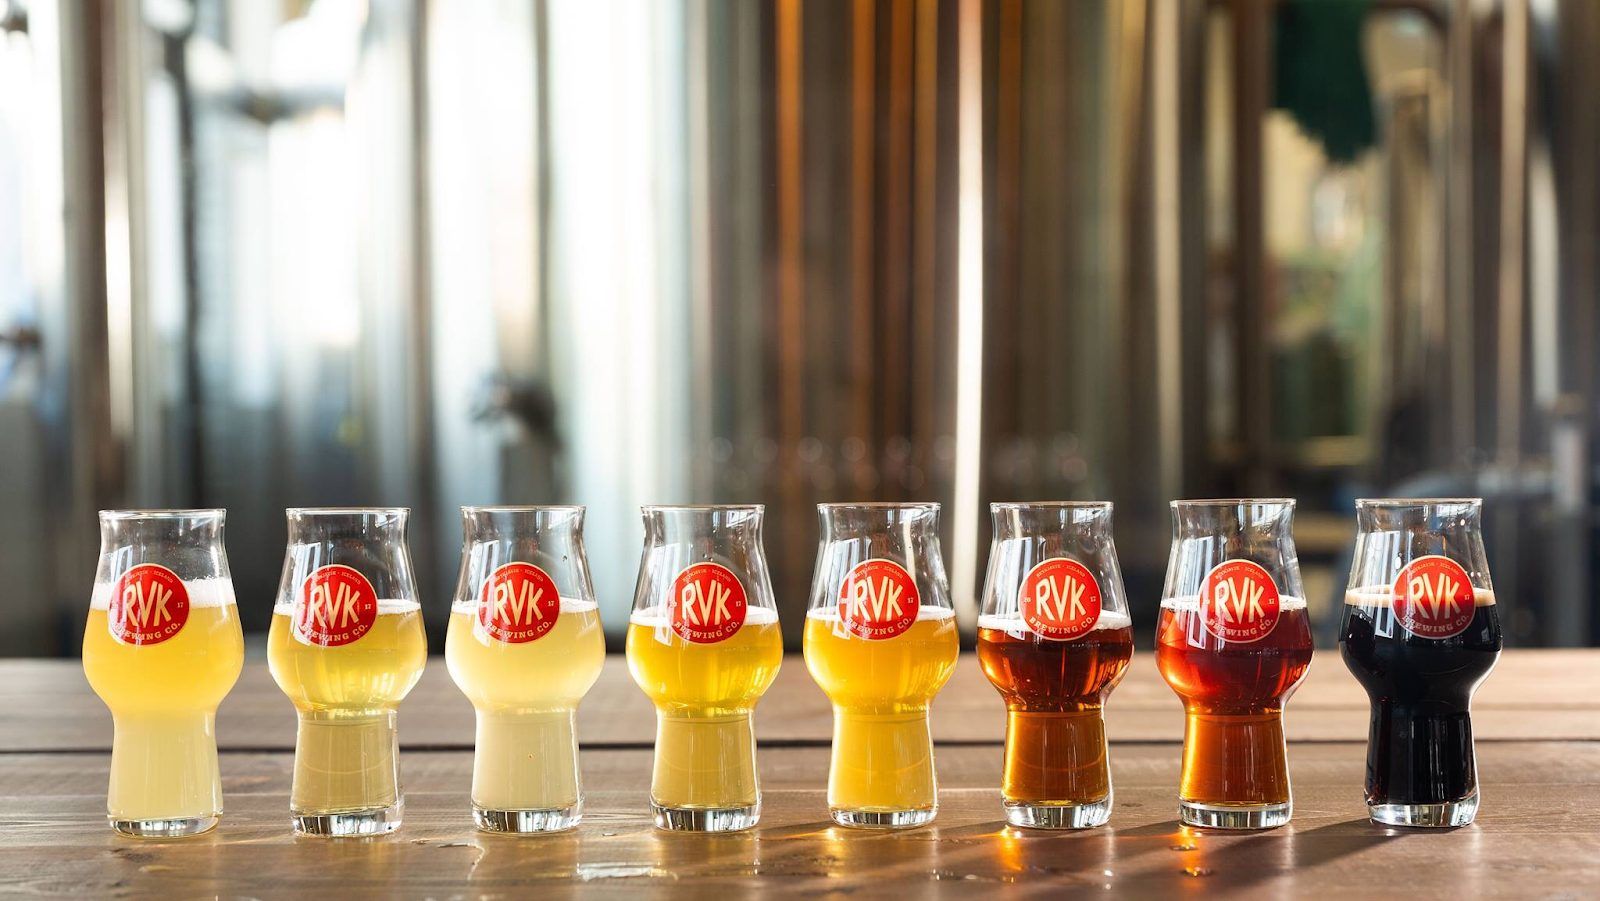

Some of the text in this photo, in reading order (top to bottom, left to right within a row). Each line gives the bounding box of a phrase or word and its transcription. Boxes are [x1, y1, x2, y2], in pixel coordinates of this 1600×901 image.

[124, 580, 173, 628] RVK
[310, 582, 360, 629] RVK
[494, 579, 544, 626] RVK
[681, 579, 731, 626] RVK
[853, 575, 904, 622] RVK
[1036, 575, 1086, 622] RVK
[1215, 576, 1266, 624] RVK
[1409, 572, 1460, 621] RVK
[165, 623, 180, 633] CO.
[353, 624, 368, 634] CO.
[487, 622, 552, 639] BREWING CO.
[674, 621, 740, 639] BREWING CO.
[847, 618, 912, 636] BREWING CO.
[1029, 617, 1095, 635] BREWING CO.
[1208, 618, 1273, 637] BREWING CO.
[1456, 615, 1470, 625] CO.
